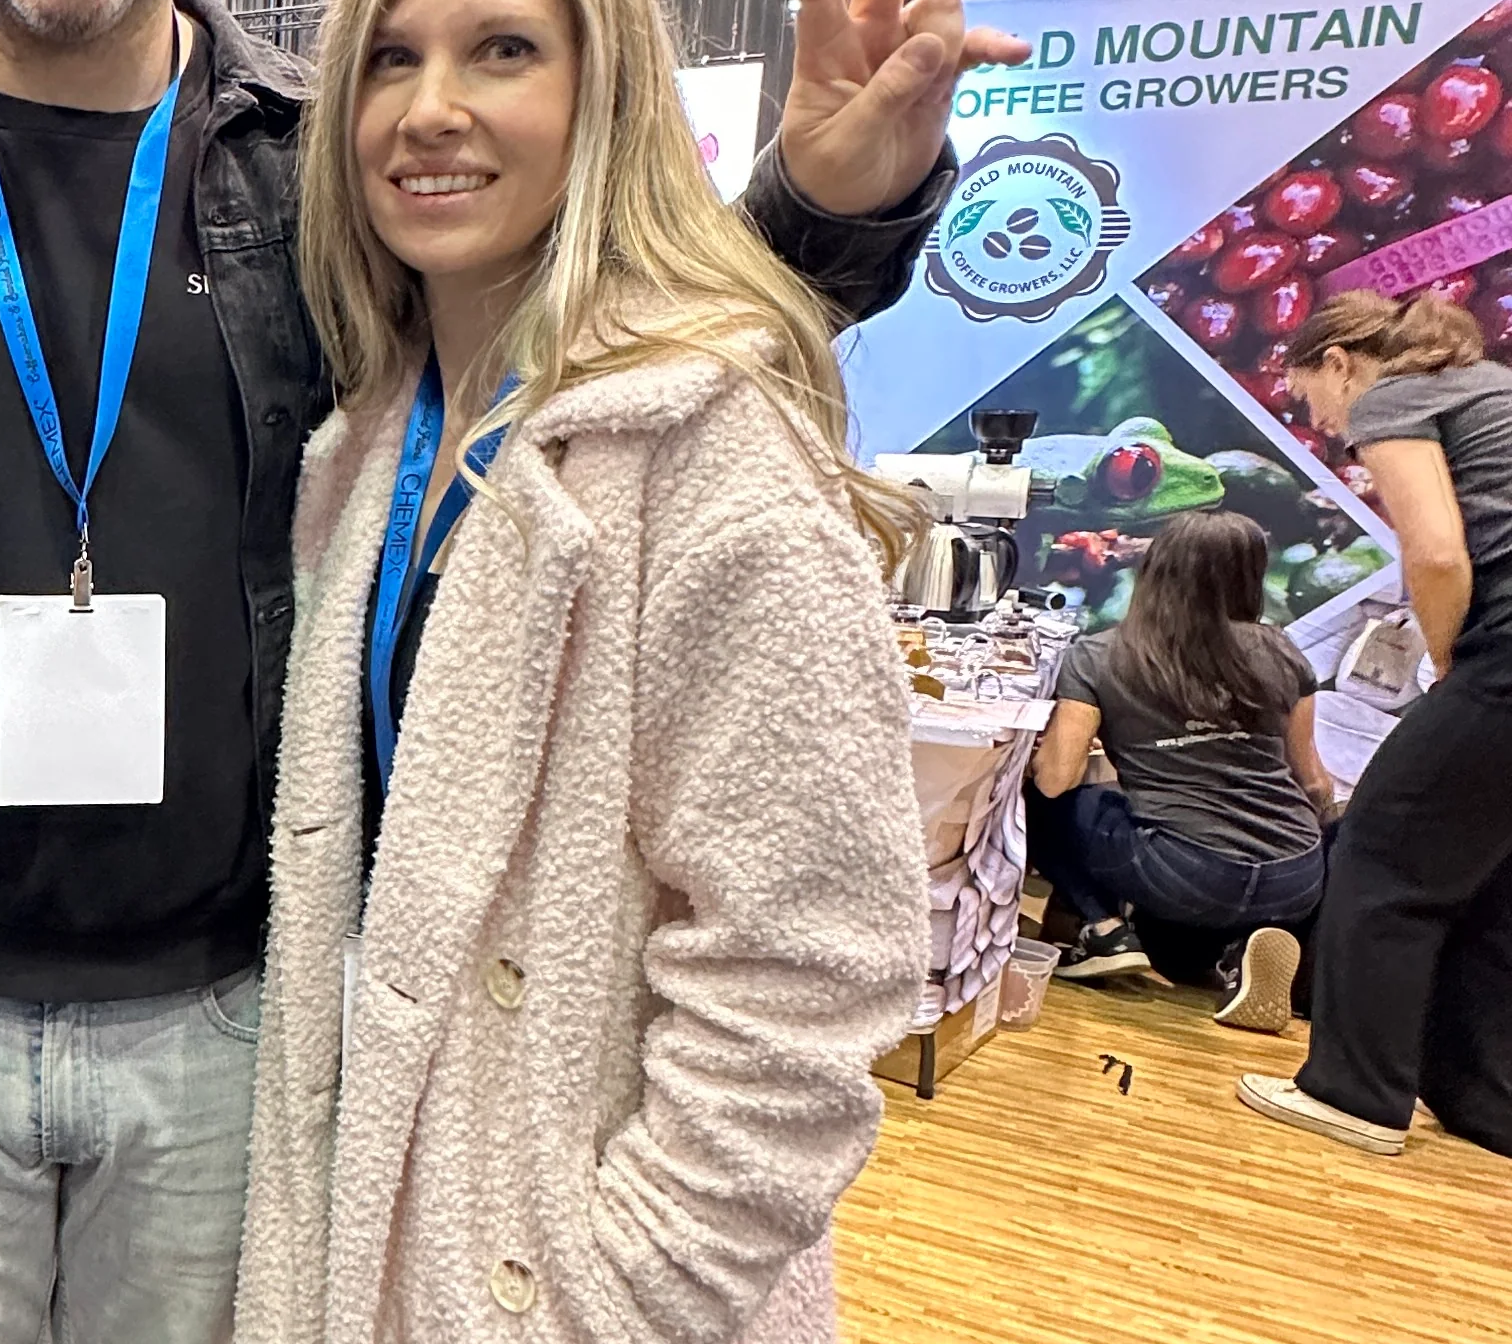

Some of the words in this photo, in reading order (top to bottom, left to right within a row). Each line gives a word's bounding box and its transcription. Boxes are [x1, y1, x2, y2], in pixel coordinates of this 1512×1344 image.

[1093, 2, 1422, 66] MOUNTAIN
[955, 82, 1085, 119] OFFEE
[1099, 65, 1349, 112] GROWERS
[961, 169, 1000, 202] GOLD
[1007, 161, 1087, 199] MOUNTAIN
[951, 249, 986, 288] COFFEE
[1059, 247, 1084, 273] LLC
[386, 473, 422, 576] CHEMEX
